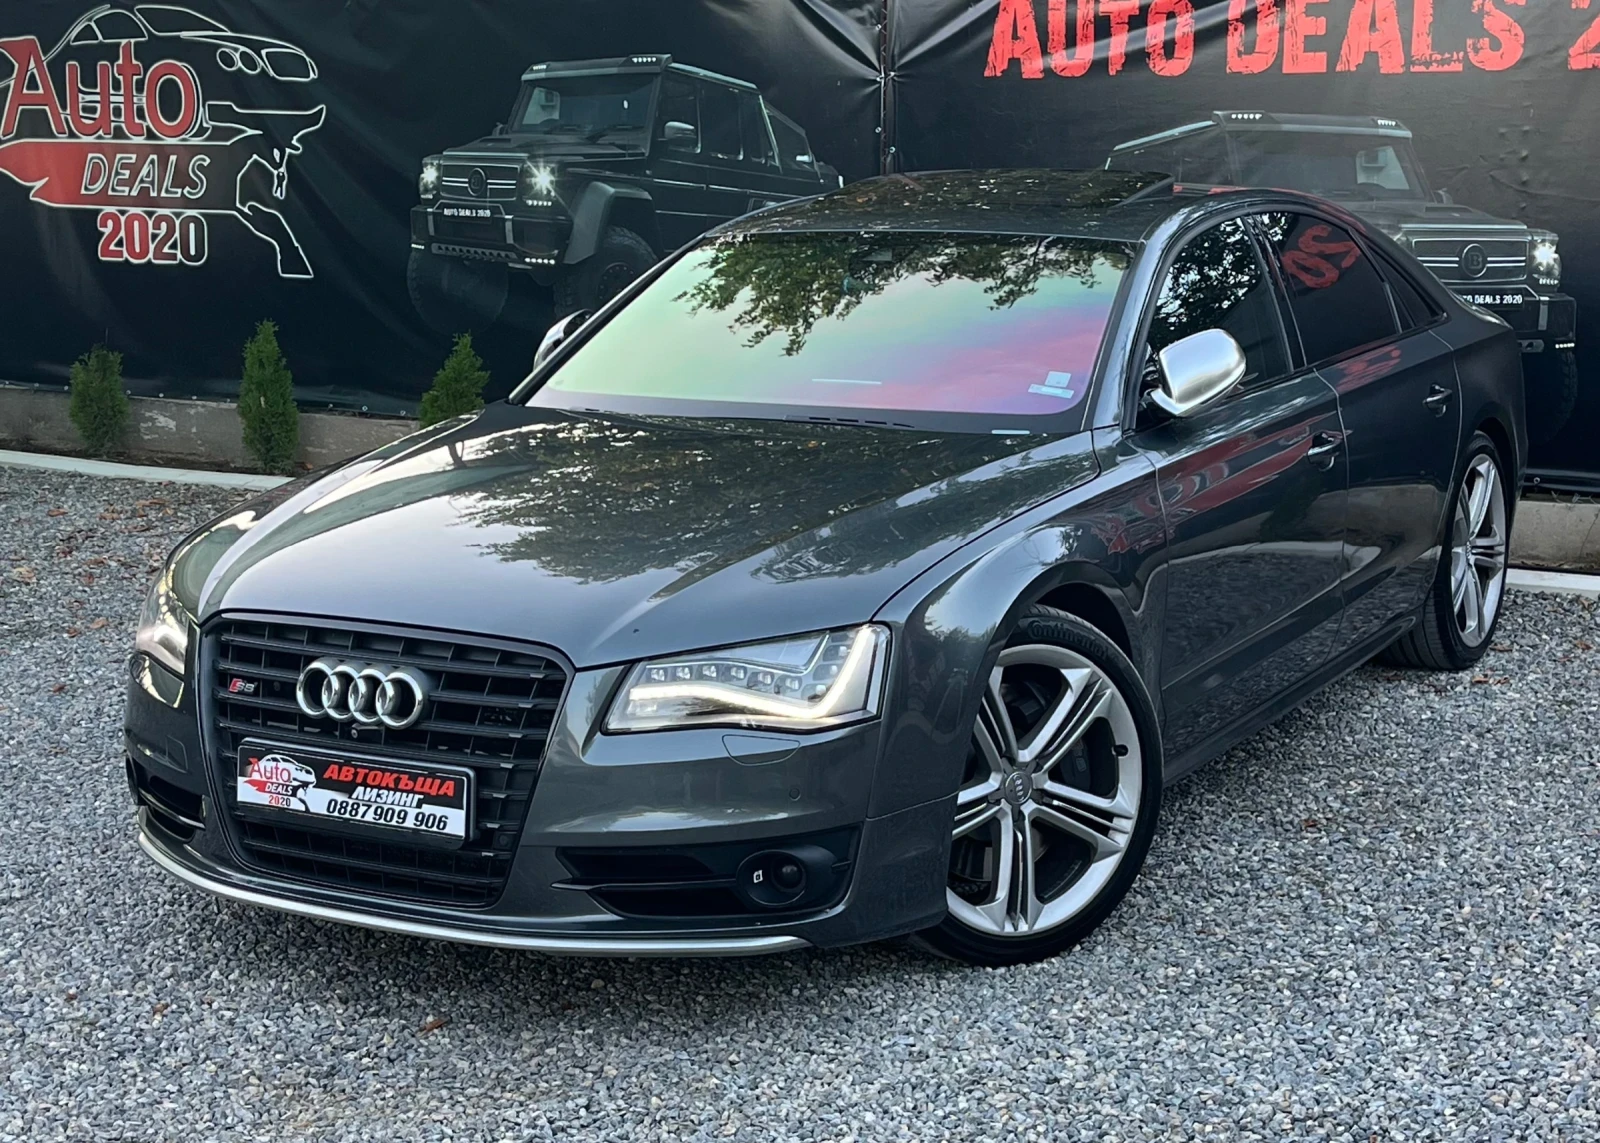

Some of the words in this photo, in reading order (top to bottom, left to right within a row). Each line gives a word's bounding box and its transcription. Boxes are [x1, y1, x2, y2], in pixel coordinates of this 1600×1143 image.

[984, 0, 1195, 79] AUTO
[1226, 0, 1525, 75] DEALS
[0, 36, 200, 139] Auto
[81, 153, 211, 199] DEALS
[443, 207, 458, 216] AUTO
[98, 210, 207, 265] 2020
[1474, 294, 1501, 304] DEALS
[1502, 294, 1523, 304] 2020
[1027, 619, 1110, 660] Continental
[248, 757, 292, 783] Auto
[323, 764, 455, 797] АВТОКЪЩА
[264, 783, 294, 795] DEALS
[268, 794, 291, 807] 2020
[351, 786, 424, 808] ЛИЗИНГ
[326, 798, 372, 819] 0887
[372, 805, 409, 825] 909
[413, 811, 449, 831] 906
